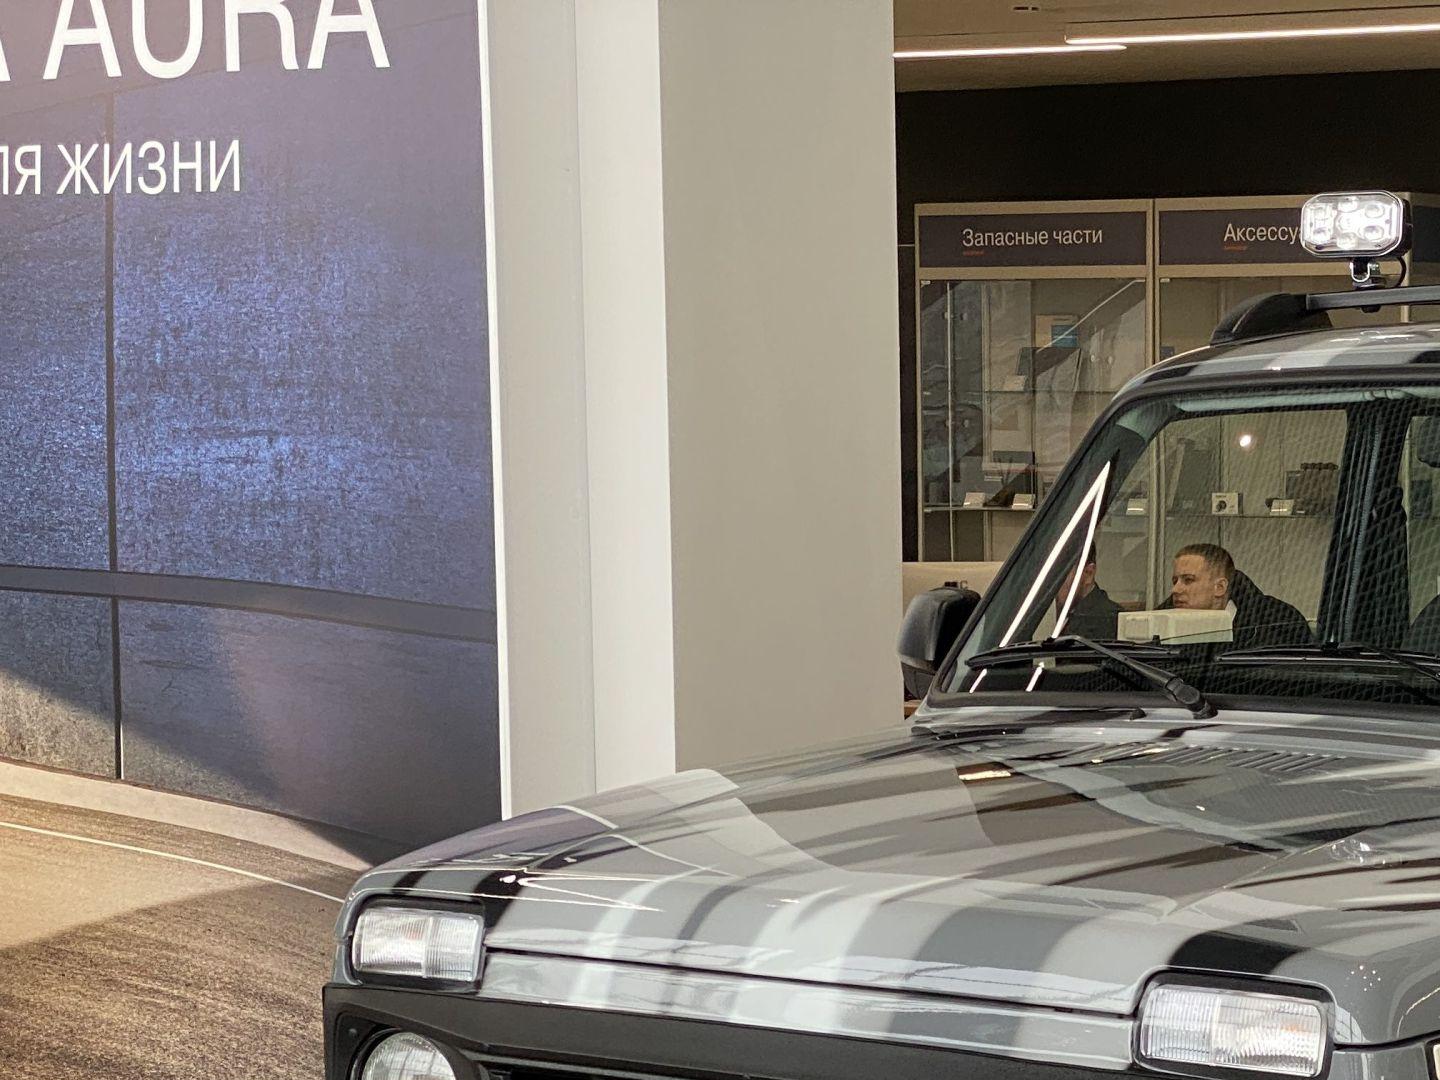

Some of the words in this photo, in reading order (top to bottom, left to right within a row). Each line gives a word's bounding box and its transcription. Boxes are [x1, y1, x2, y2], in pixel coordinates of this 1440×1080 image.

[43, 0, 390, 80] AURA
[56, 139, 241, 195] ЖИЗНИ
[962, 228, 1049, 247] Запасные
[1053, 229, 1103, 245] части
[1223, 223, 1301, 245] Аксессу
